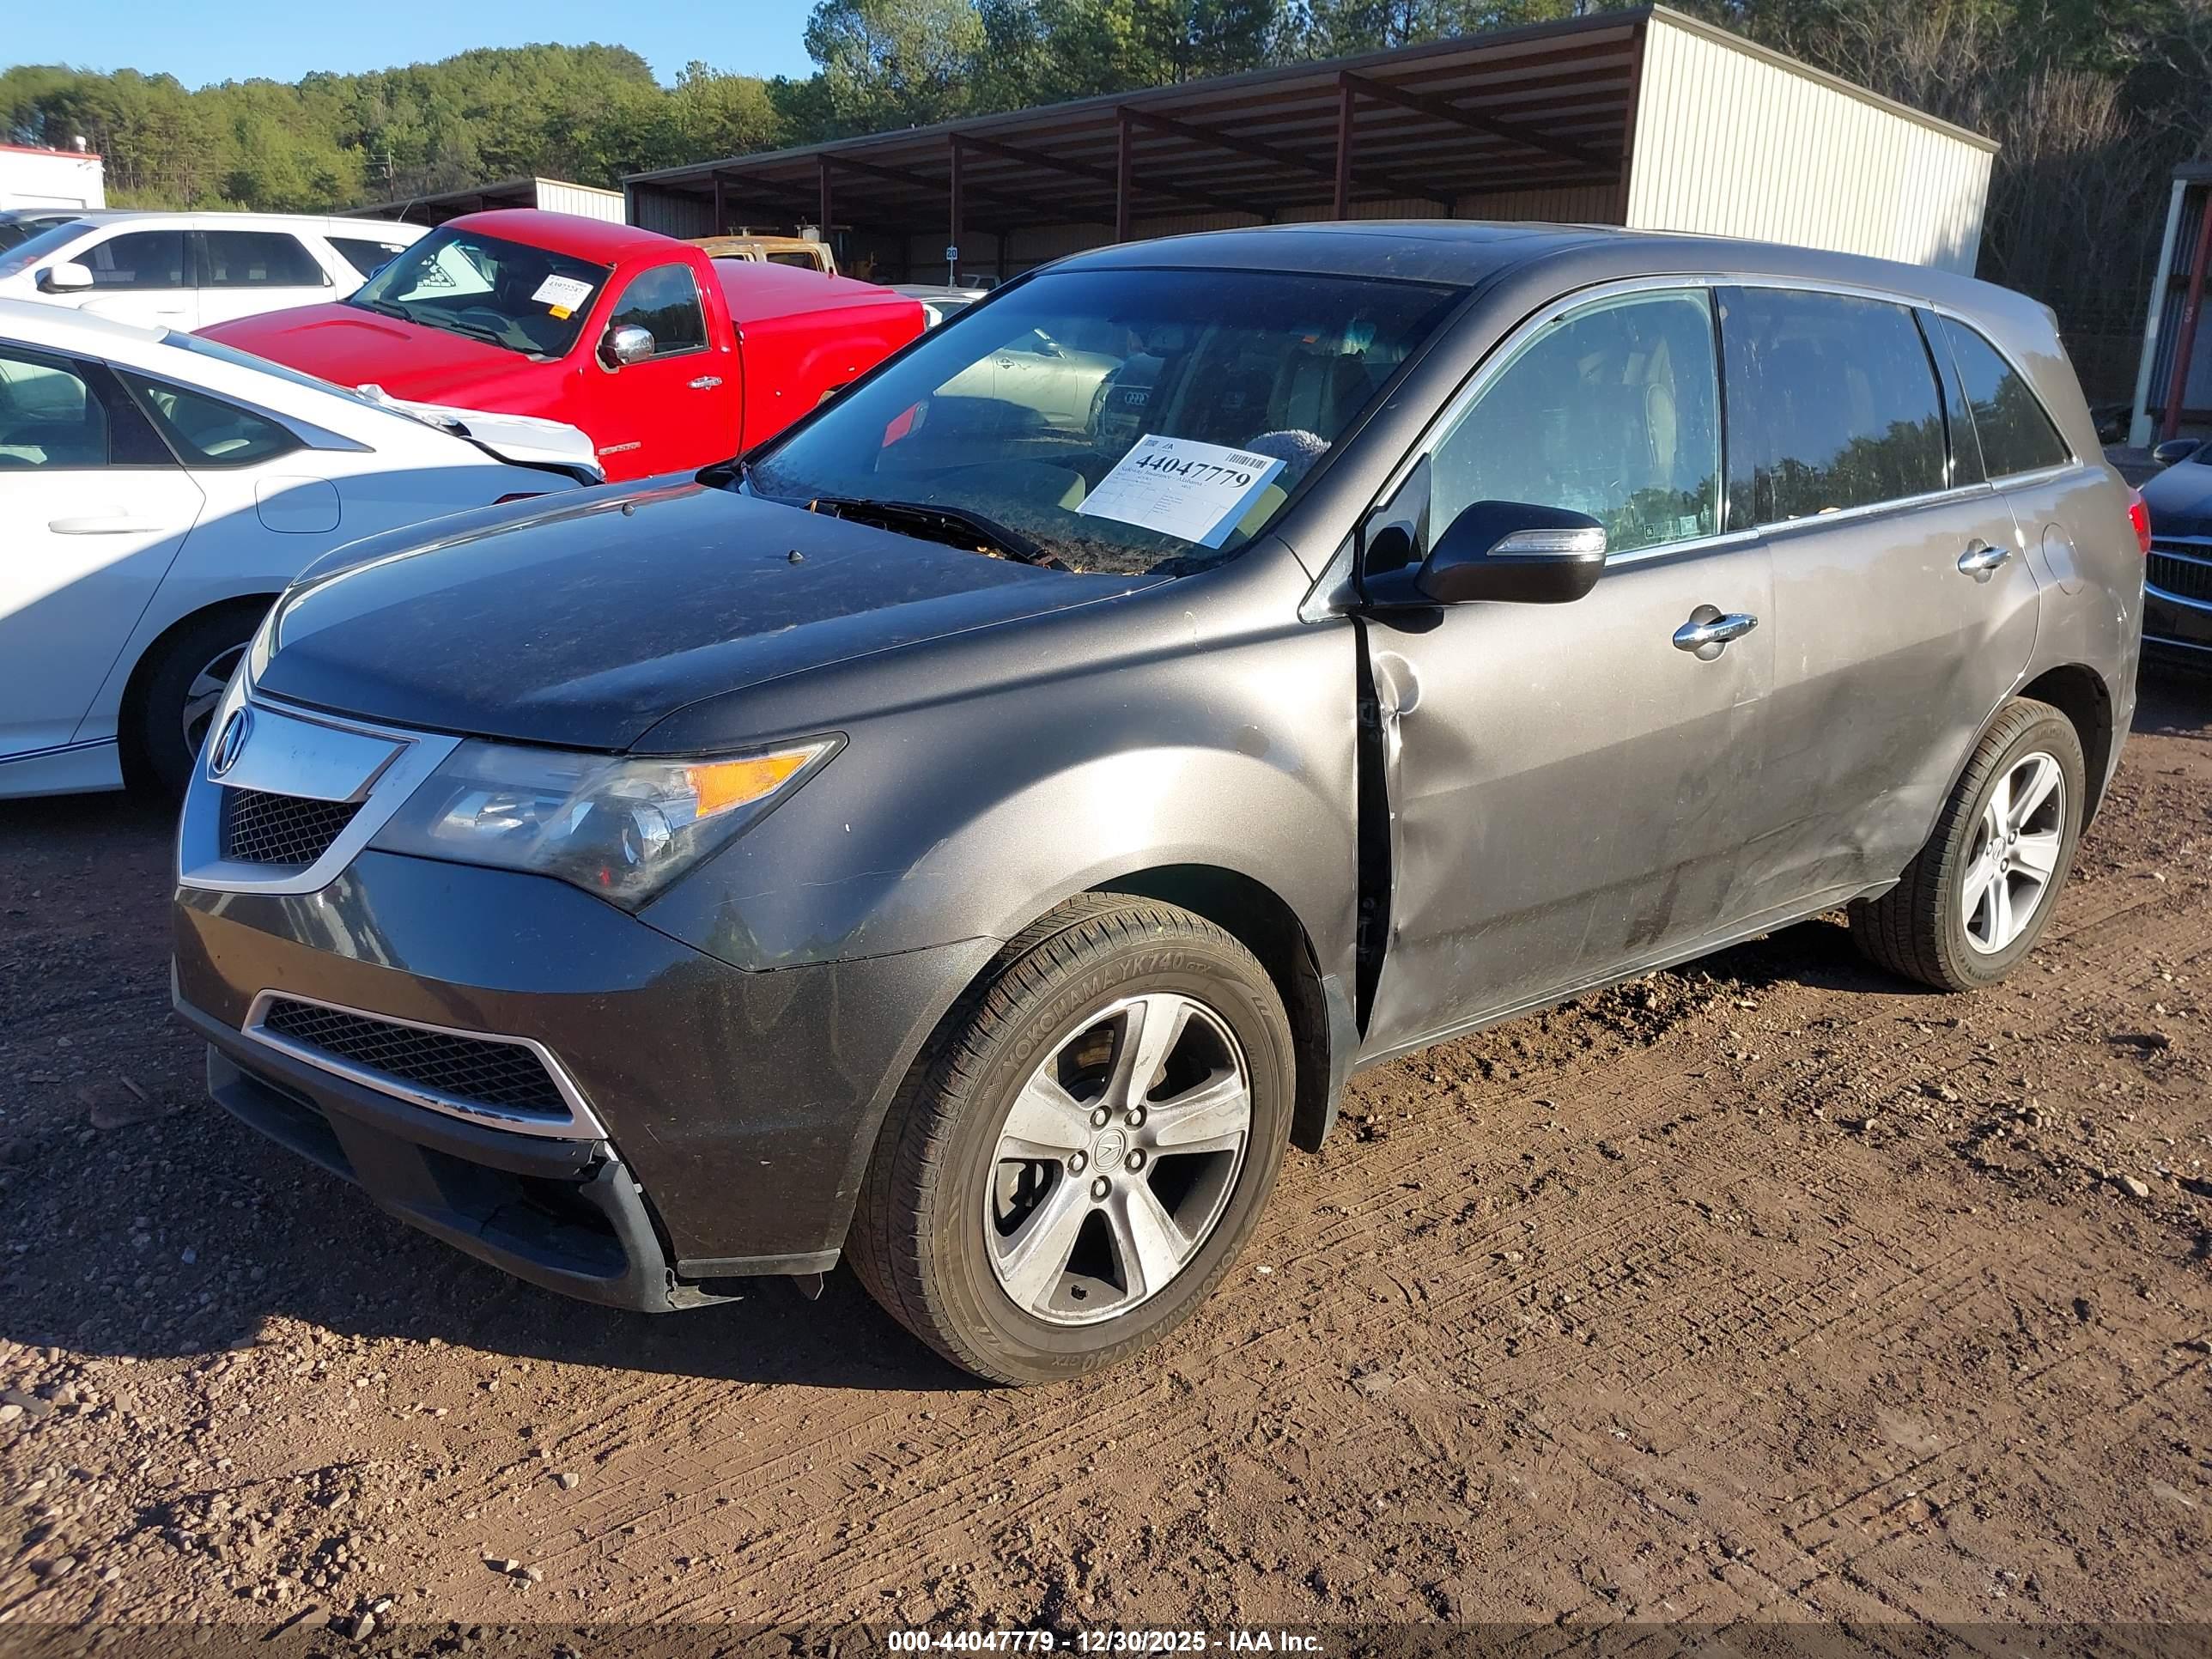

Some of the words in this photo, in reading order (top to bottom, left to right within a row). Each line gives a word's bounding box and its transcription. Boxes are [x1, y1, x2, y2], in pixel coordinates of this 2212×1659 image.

[947, 249, 957, 258] 20
[1135, 453, 1252, 489] 44047779
[1002, 970, 1116, 1072] YOKOHAMA
[1117, 950, 1186, 981] YK740
